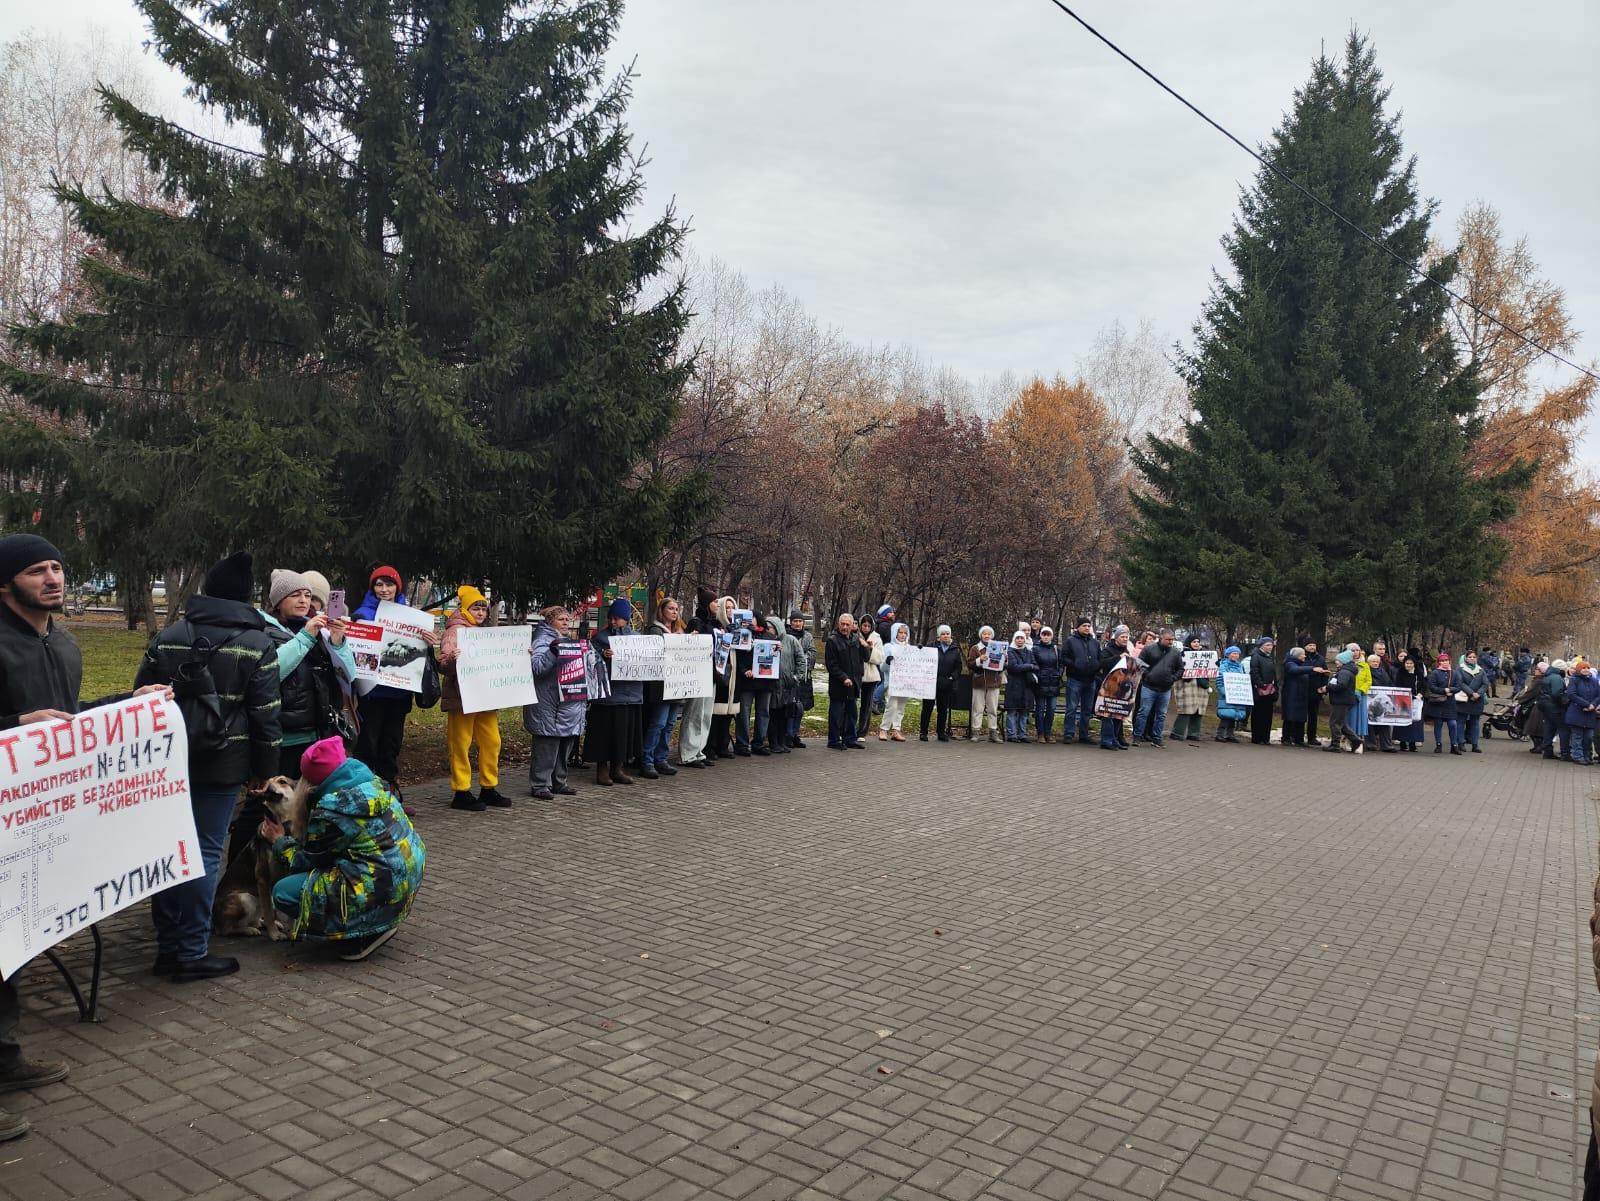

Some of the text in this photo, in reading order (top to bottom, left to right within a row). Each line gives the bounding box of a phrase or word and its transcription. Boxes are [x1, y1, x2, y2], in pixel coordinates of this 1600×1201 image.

[396, 622, 426, 636] ПРОТИ
[616, 665, 664, 678] ЖИВОТНЫХ
[1192, 660, 1210, 668] БЕЗ
[0, 699, 168, 776] ТЗОВИТЕ
[0, 764, 94, 806] АКОНОПРОЕКТ
[1, 794, 77, 831] УБИЙСТВЕ
[83, 767, 168, 806] БЕЗДОМНЫХ
[98, 779, 188, 816] ЖИВОТНЫХ
